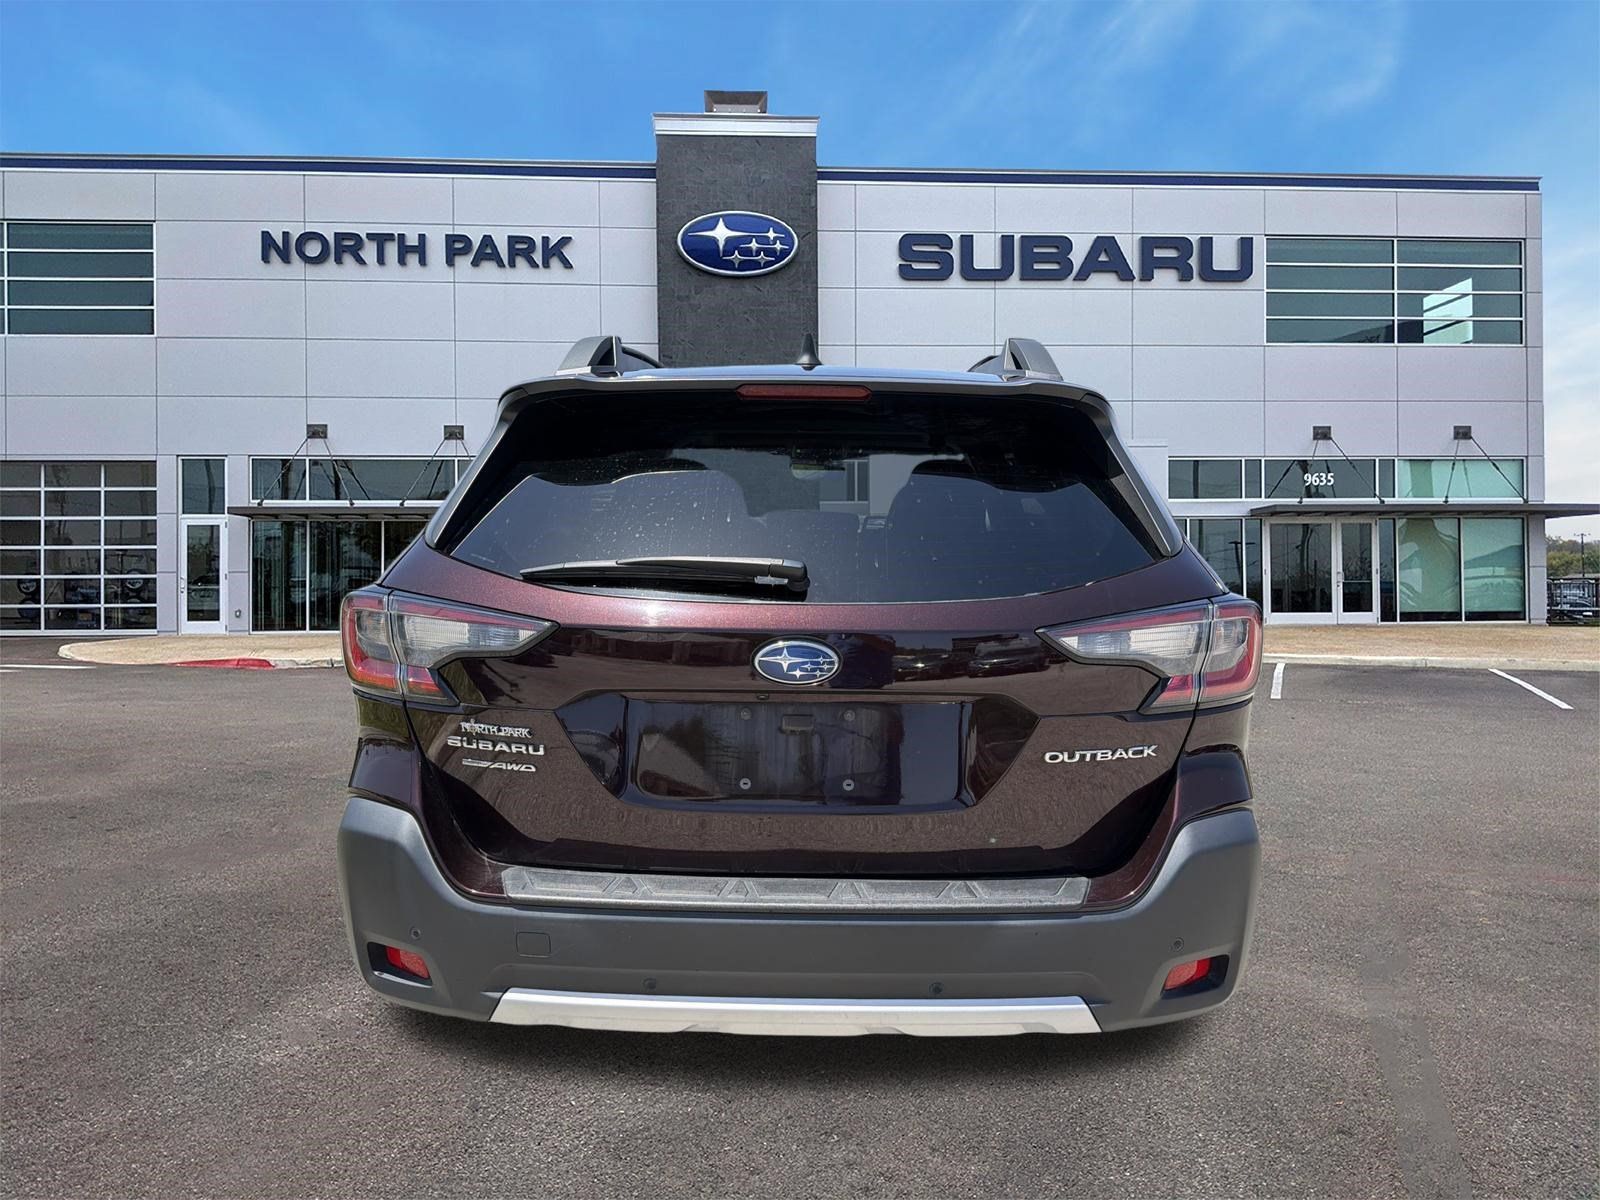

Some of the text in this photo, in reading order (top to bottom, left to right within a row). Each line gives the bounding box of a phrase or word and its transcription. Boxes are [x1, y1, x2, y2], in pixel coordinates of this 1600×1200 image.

[260, 230, 574, 269] NORTH PARK
[898, 233, 1254, 282] SUBARU
[1303, 472, 1335, 486] 9635
[499, 725, 532, 739] PARK
[447, 735, 545, 756] SUBARU
[1044, 744, 1158, 763] OUTBACK
[489, 761, 537, 772] AWD
